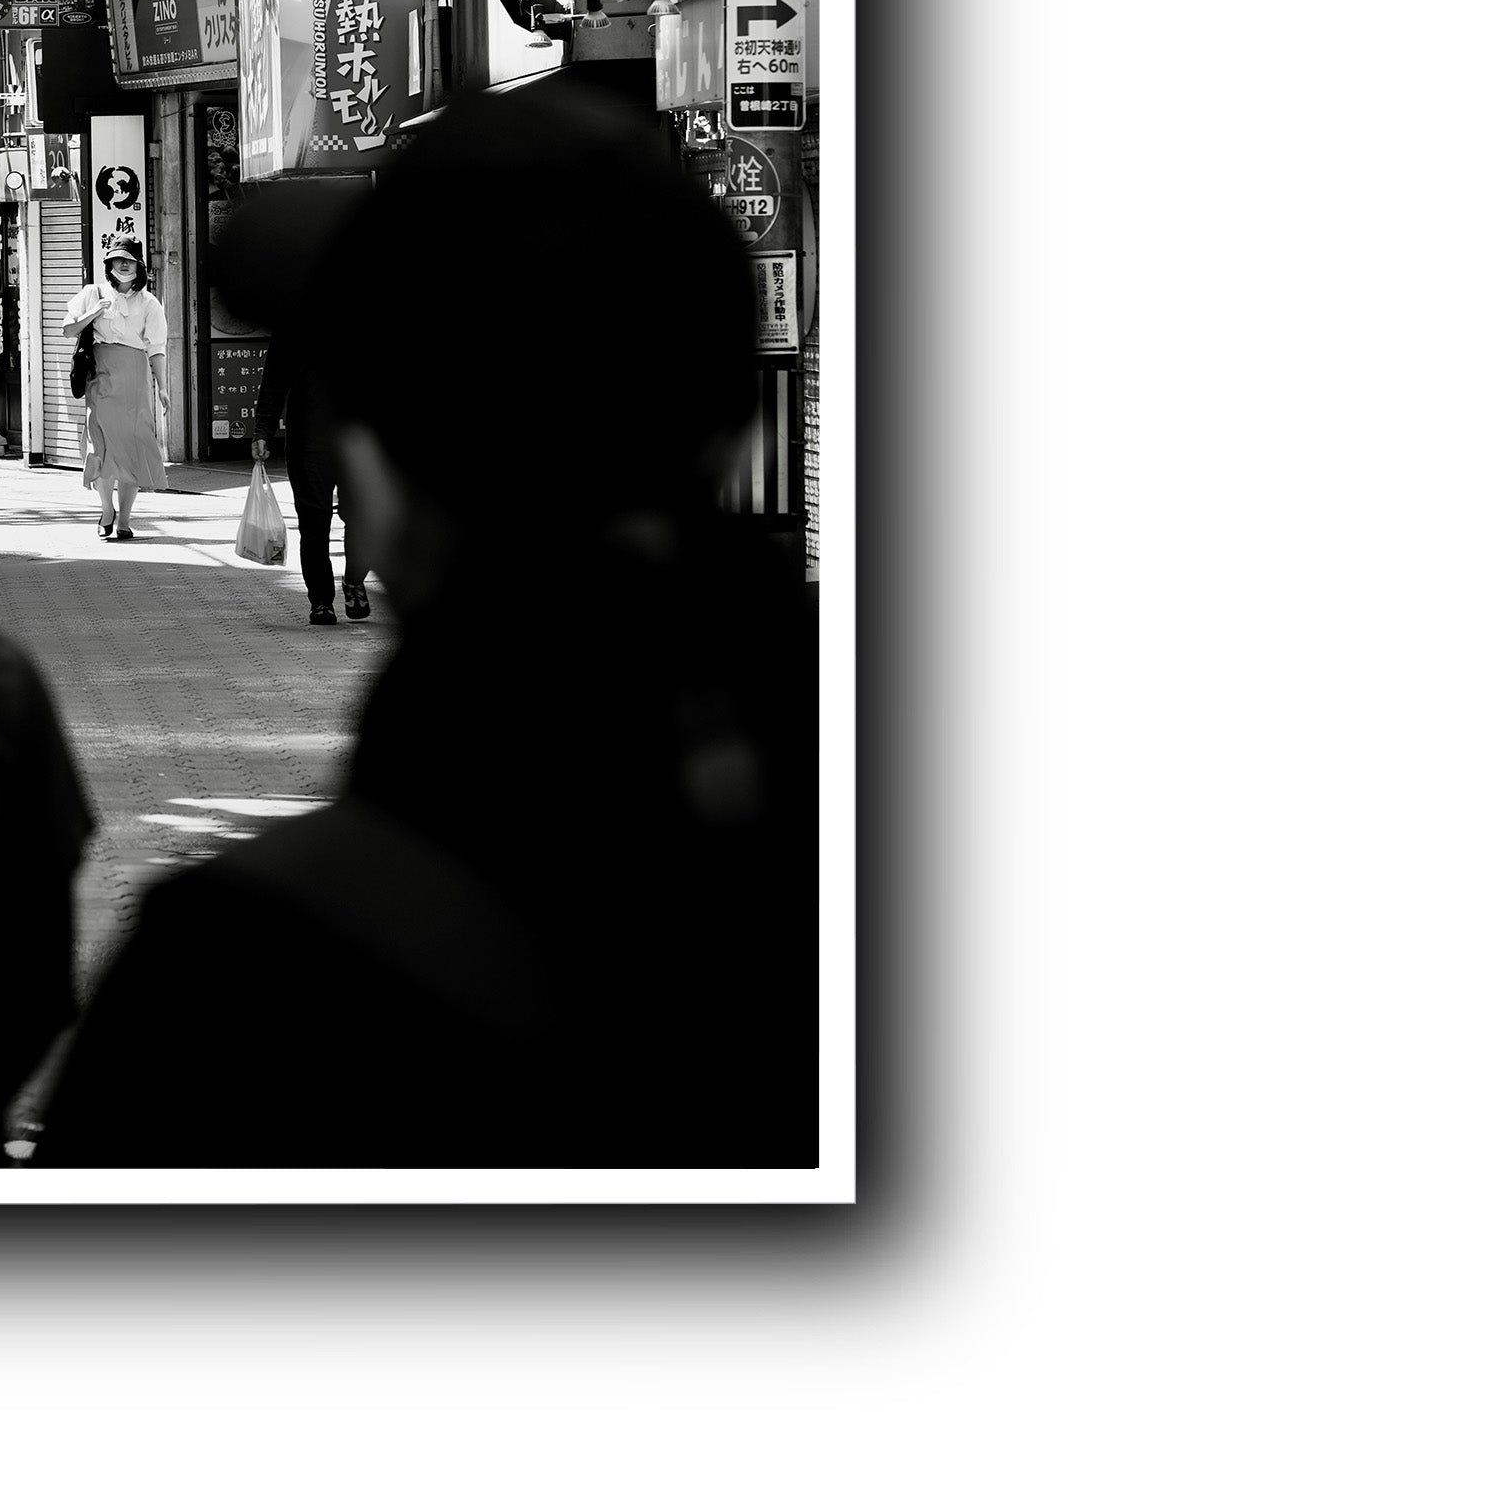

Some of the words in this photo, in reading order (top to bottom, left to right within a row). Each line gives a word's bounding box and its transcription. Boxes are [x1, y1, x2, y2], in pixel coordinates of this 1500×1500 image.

[18, 6, 38, 25] 6F
[734, 39, 801, 56] お初天神通り
[736, 58, 800, 75] 右へ60m
[733, 86, 756, 95] ここは
